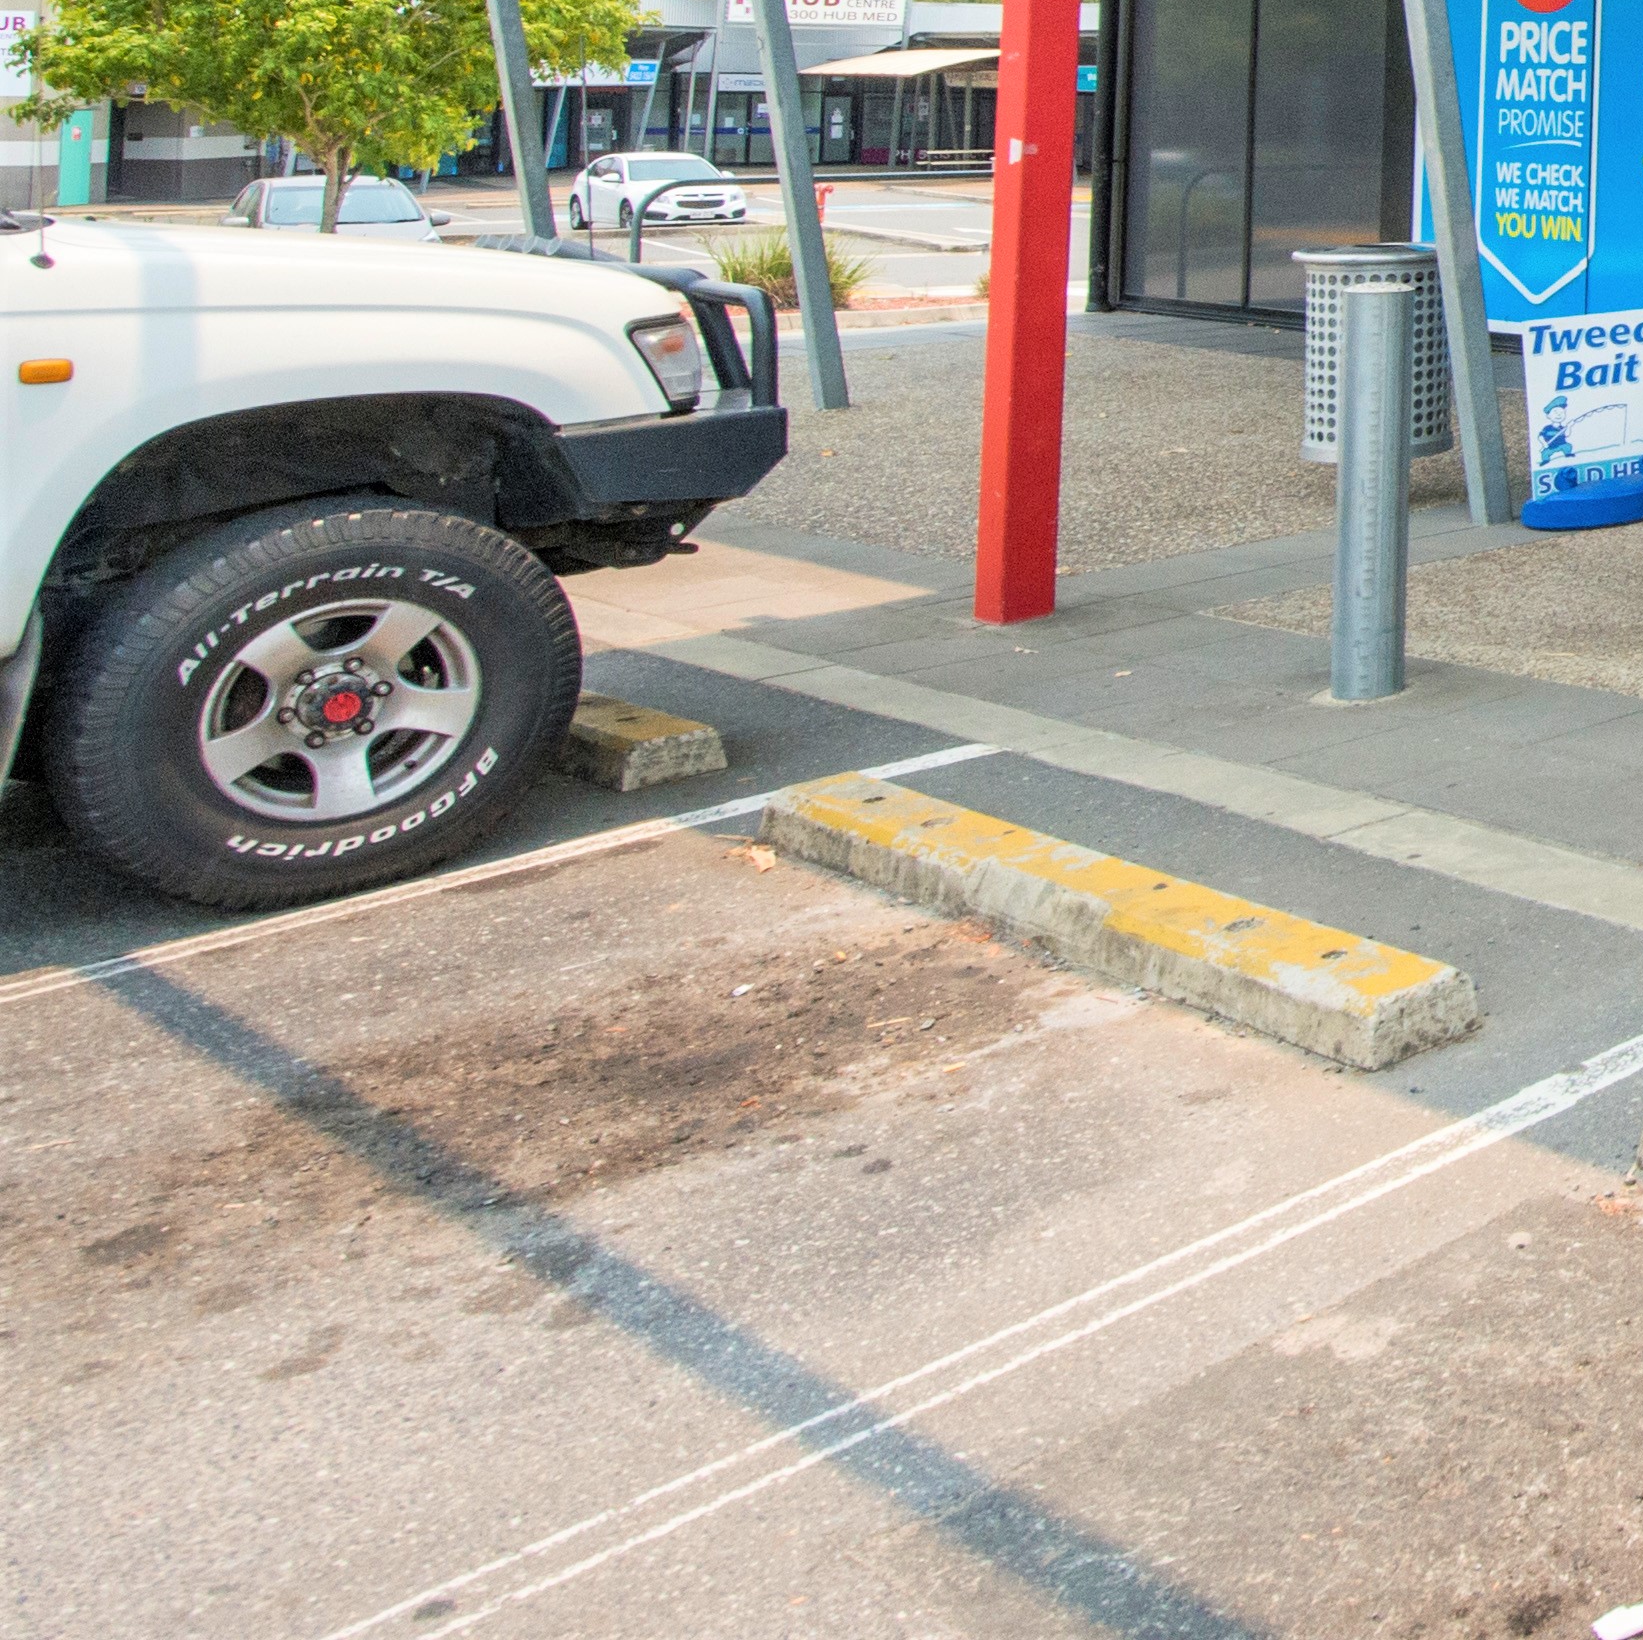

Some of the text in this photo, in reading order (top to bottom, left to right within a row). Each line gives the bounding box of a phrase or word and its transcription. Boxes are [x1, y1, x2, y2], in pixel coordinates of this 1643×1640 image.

[789, 10, 898, 22] 300 HUB MED
[846, 0, 896, 9] CENTRE
[0, 16, 26, 30] UB
[1500, 20, 1588, 64] PRICE
[1495, 68, 1587, 103] MATCH
[1498, 108, 1585, 138] PROMISE
[1495, 161, 1521, 185] WE
[1495, 187, 1520, 210] WE
[1495, 211, 1536, 240] YOU
[1555, 352, 1640, 392] Bait
[177, 562, 478, 687] All-Terrain T/A
[226, 746, 500, 861] BFGoodrich
